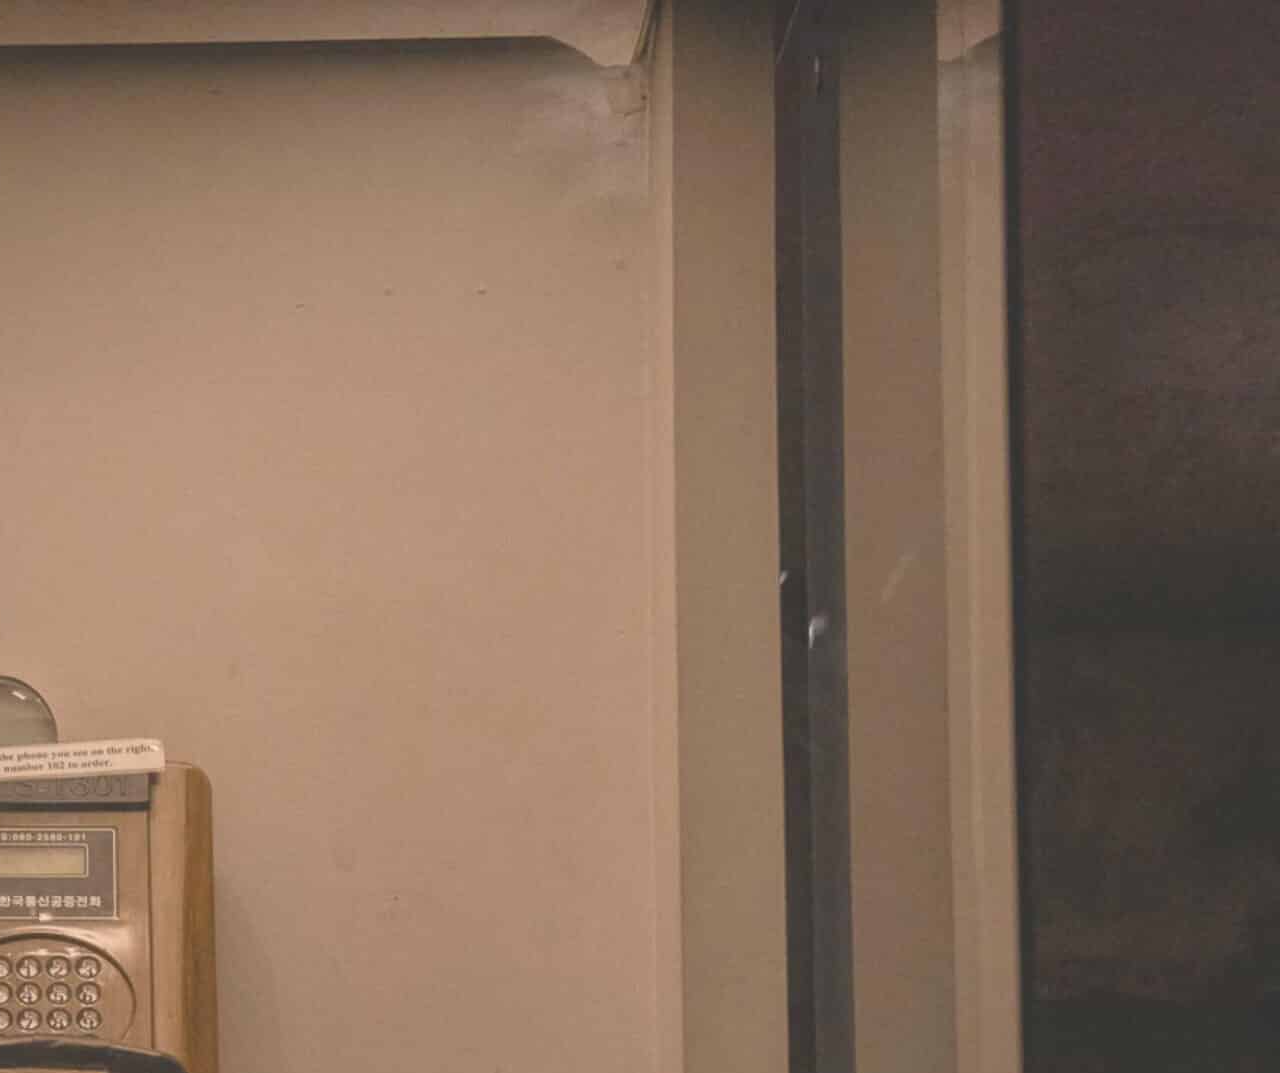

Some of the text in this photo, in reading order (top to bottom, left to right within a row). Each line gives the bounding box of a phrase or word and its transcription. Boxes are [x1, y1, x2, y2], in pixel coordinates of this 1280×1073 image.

[17, 752, 49, 762] phone
[51, 751, 70, 760] you
[107, 745, 122, 754] the
[4, 763, 44, 774] number
[68, 760, 78, 769] to
